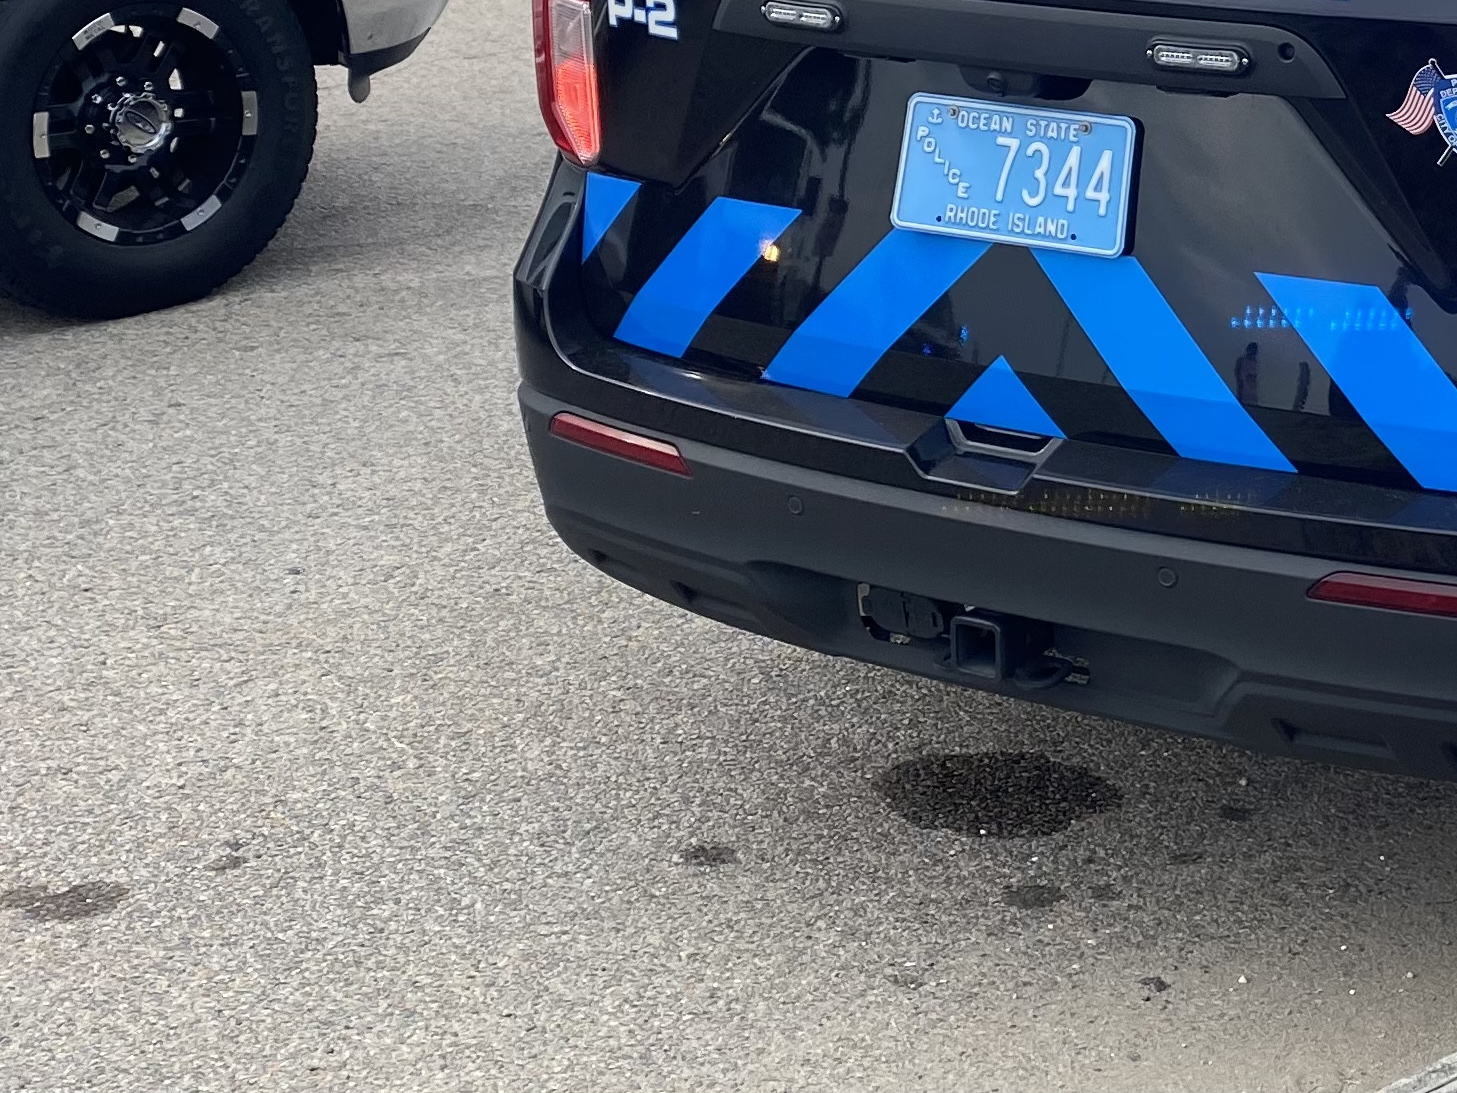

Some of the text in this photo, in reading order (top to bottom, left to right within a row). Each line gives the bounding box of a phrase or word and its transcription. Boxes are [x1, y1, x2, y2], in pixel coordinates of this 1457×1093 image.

[957, 110, 1080, 142] OCEAN STATE
[1436, 113, 1452, 134] CITY
[916, 125, 971, 199] POLICE
[995, 136, 1113, 217] 7344
[945, 203, 1069, 240] RHODE ISLAND
